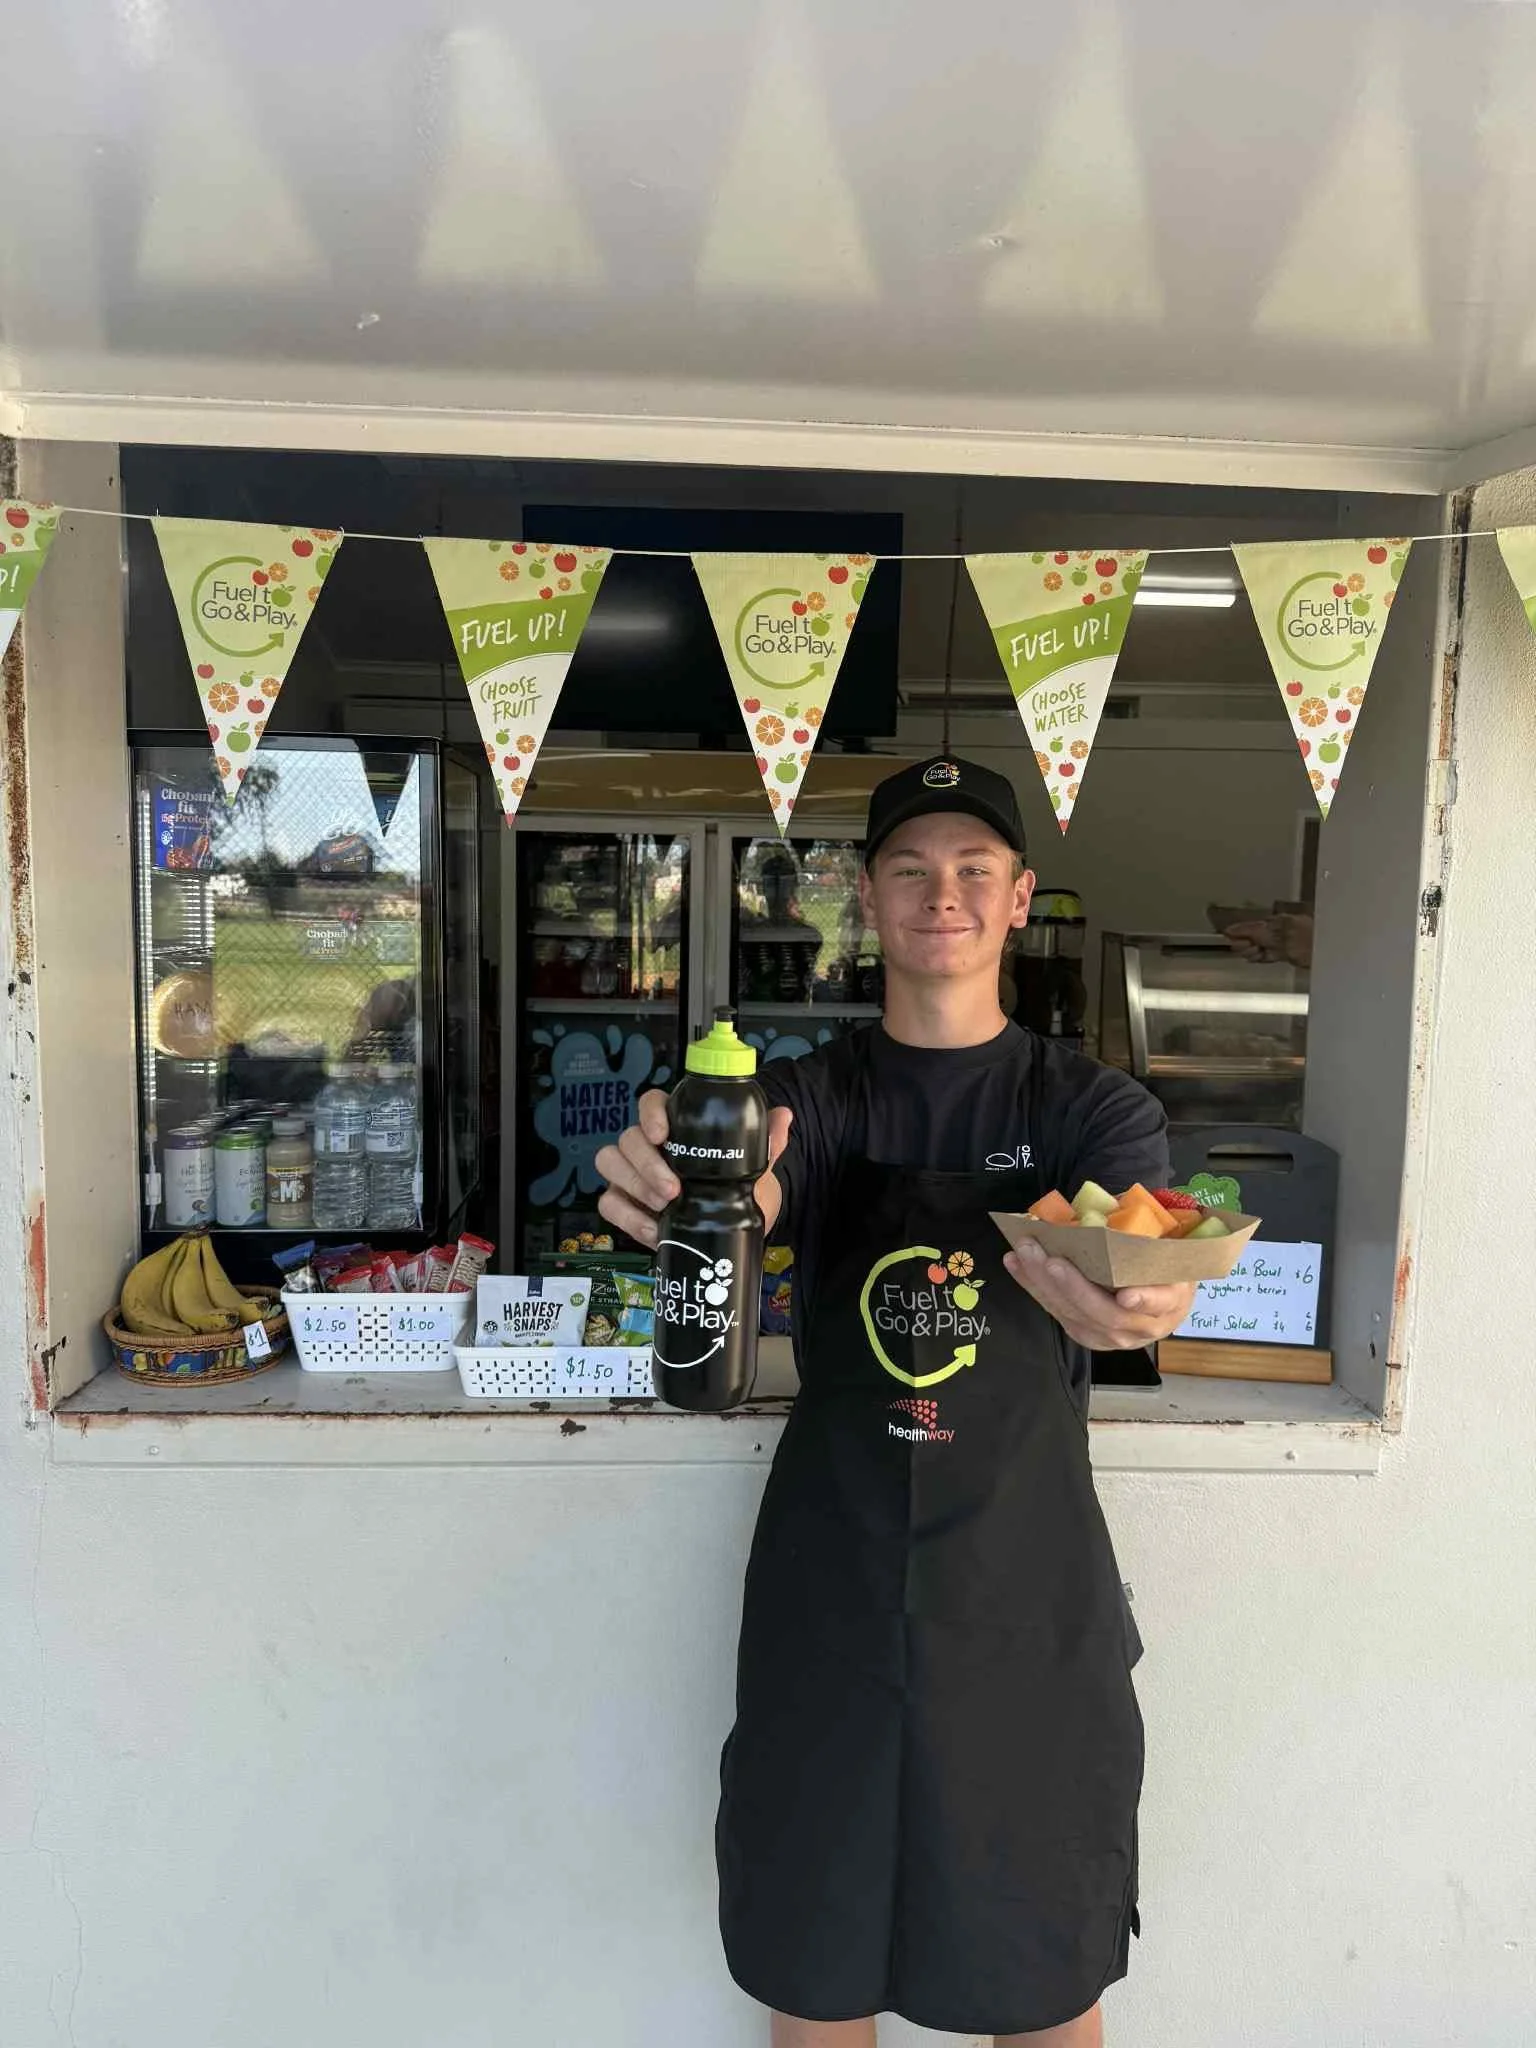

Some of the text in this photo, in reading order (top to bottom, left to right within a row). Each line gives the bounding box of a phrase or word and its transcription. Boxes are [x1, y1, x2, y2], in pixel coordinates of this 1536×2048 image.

[213, 581, 257, 602] Fuel
[1298, 598, 1339, 617] Fuel
[461, 609, 567, 654] FUEL UP!
[756, 614, 797, 634] Fuel
[1010, 612, 1110, 669] FUEL UP!
[480, 675, 537, 703] CHOOSE
[1032, 682, 1087, 714] CHOOSE
[493, 695, 543, 724] FRUIT
[1035, 704, 1089, 732] WATER
[560, 1080, 630, 1110] WATER
[560, 1105, 630, 1138] WINS!
[1254, 1259, 1282, 1278] Bowl
[883, 1283, 938, 1310] Fuel
[503, 1301, 564, 1321] HARVEST
[1190, 1311, 1221, 1329] Fruit
[1223, 1314, 1259, 1331] Salad
[304, 1316, 347, 1332] $2.50
[398, 1316, 435, 1332] $1.00
[514, 1318, 551, 1332] SNAPS
[565, 1356, 613, 1379] $1.50
[888, 1421, 954, 1443] healthway
